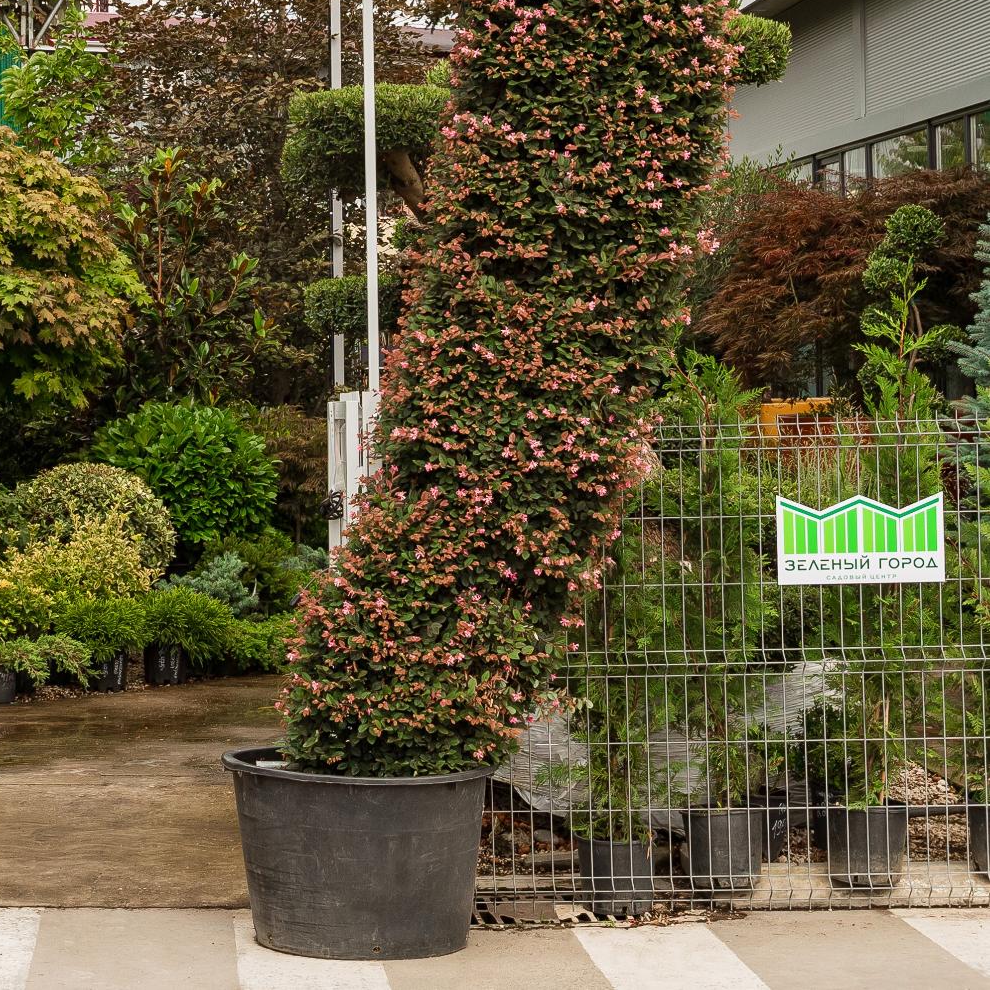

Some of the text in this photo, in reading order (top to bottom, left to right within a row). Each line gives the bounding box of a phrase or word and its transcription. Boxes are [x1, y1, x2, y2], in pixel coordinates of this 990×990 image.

[784, 555, 938, 572] ЗЕЛЕНЫЙ ГОРОД
[826, 573, 867, 581] САДОВЫЙ
